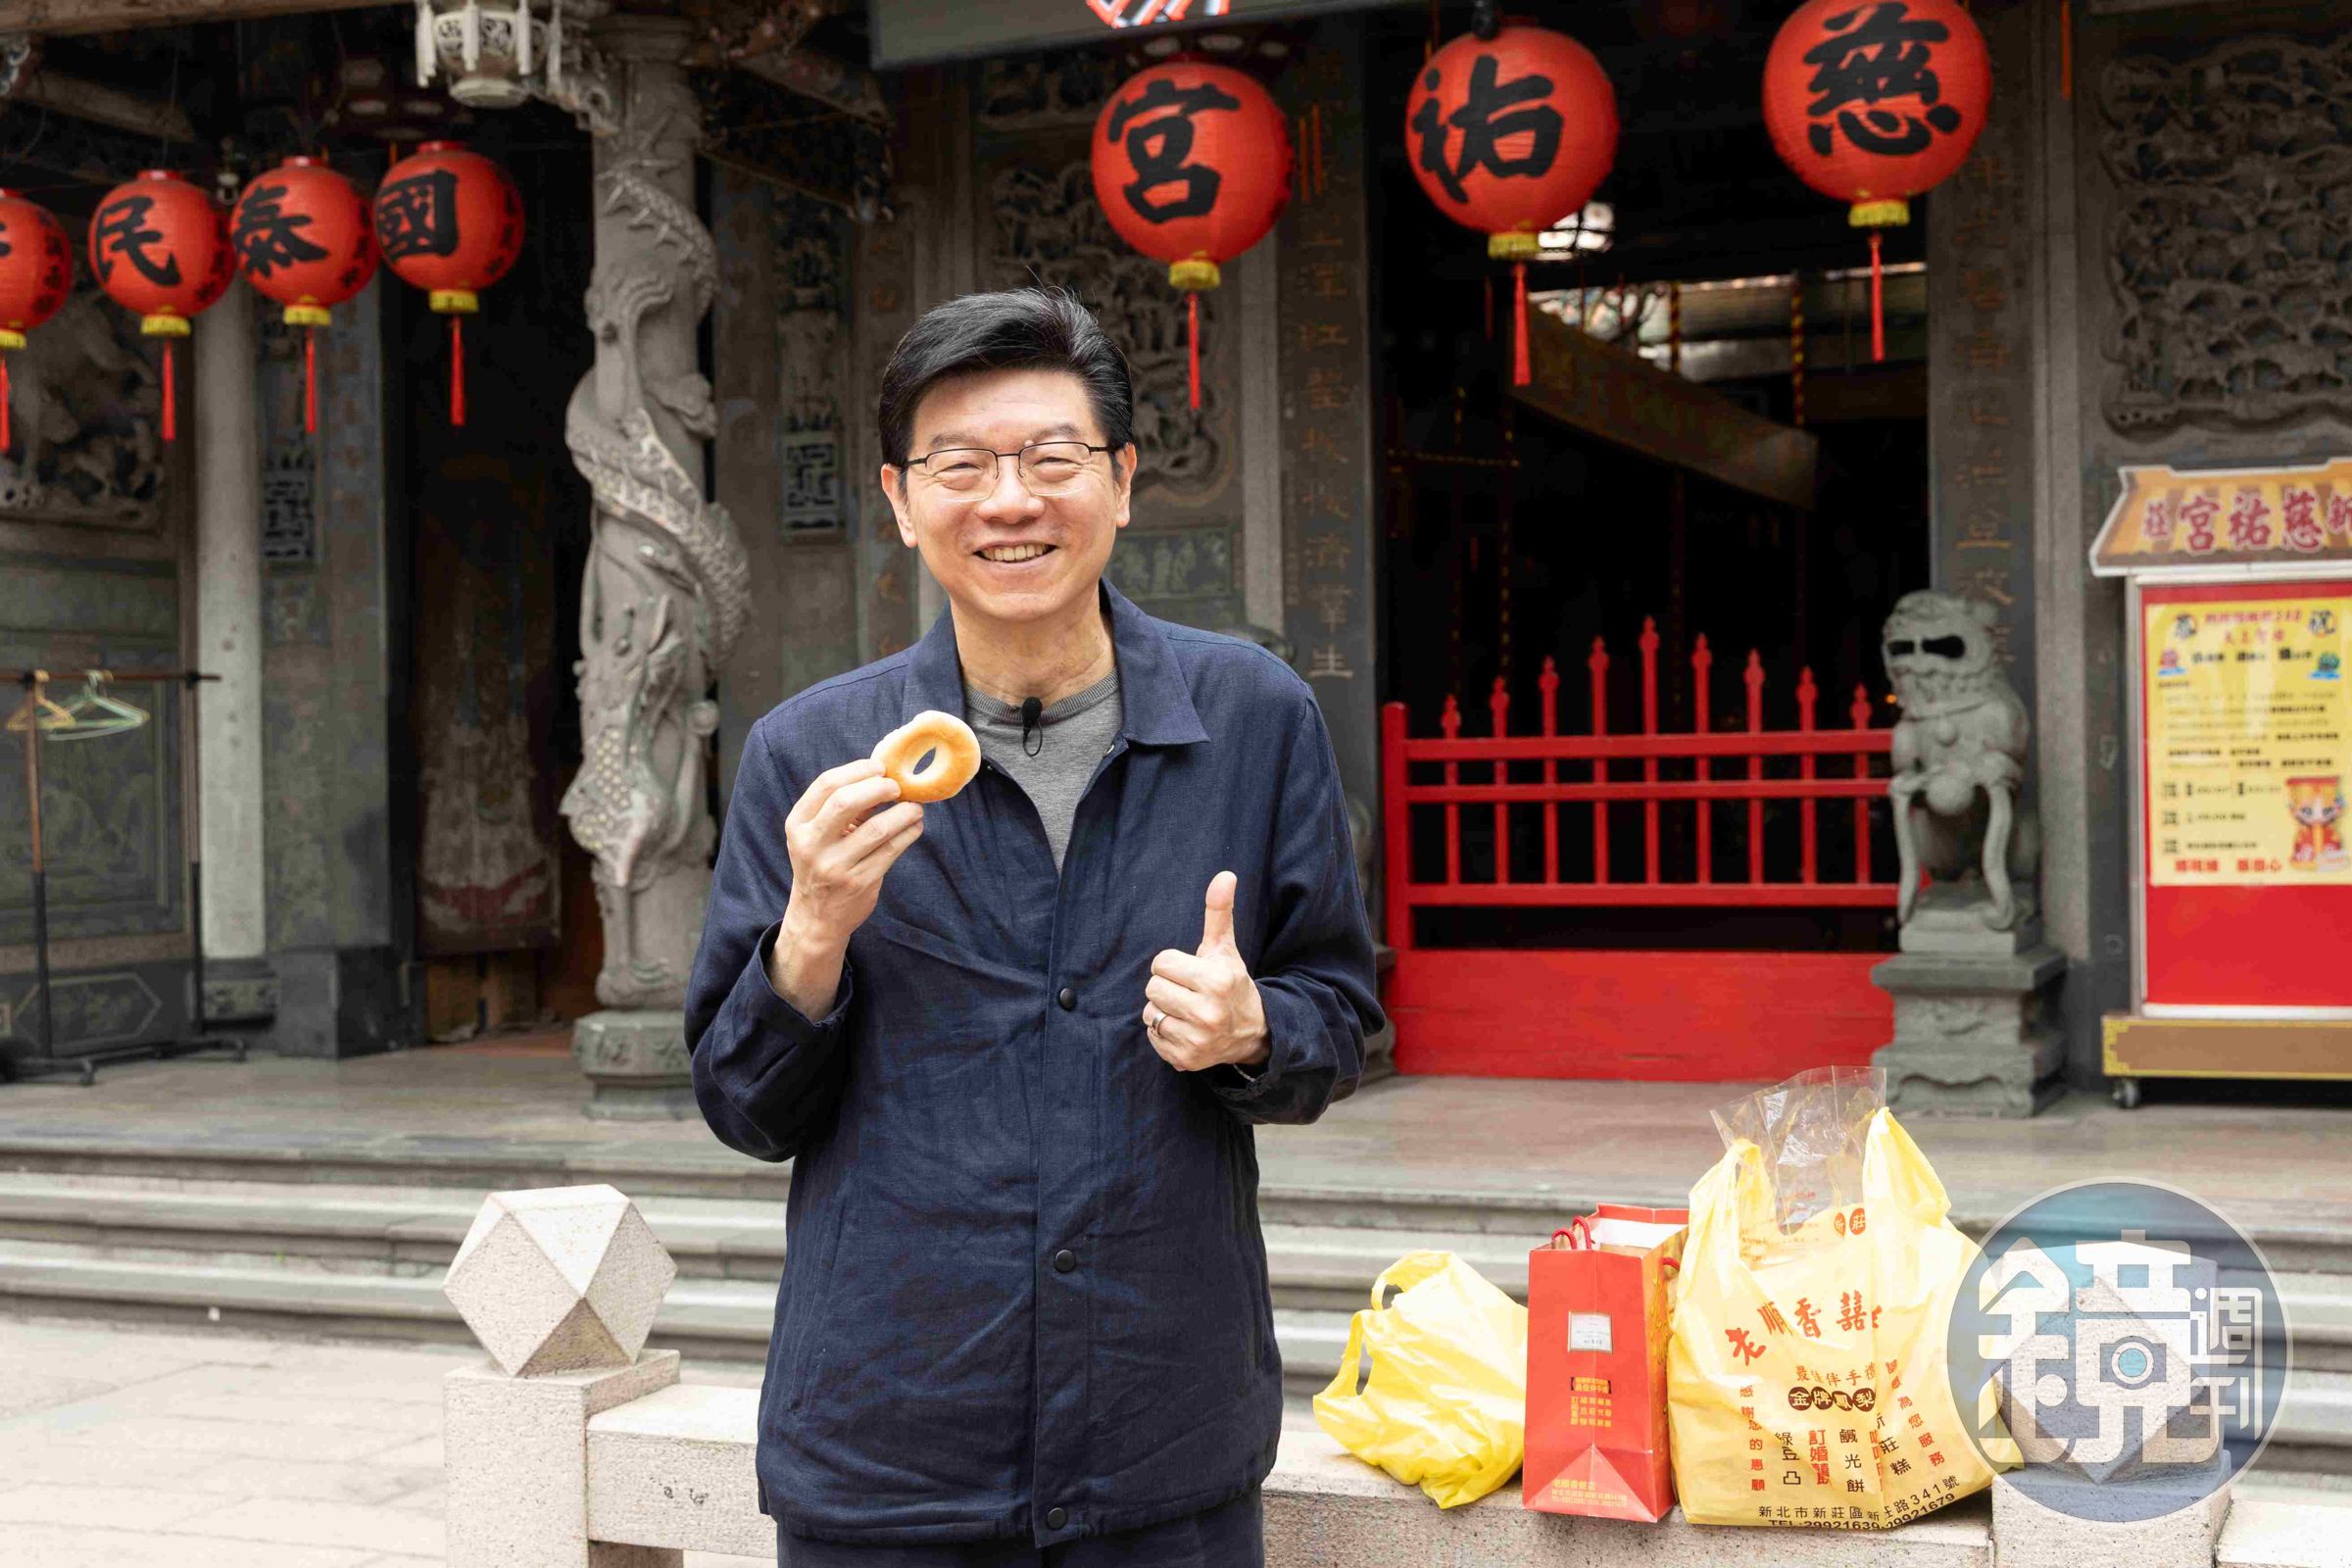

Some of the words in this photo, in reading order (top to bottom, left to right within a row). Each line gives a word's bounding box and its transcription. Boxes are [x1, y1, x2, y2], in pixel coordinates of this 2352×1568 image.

[1803, 2, 1961, 157] 慈
[1107, 79, 1241, 223] 宮
[95, 196, 182, 287] 民
[233, 184, 329, 278] 泰
[376, 169, 459, 263] 國
